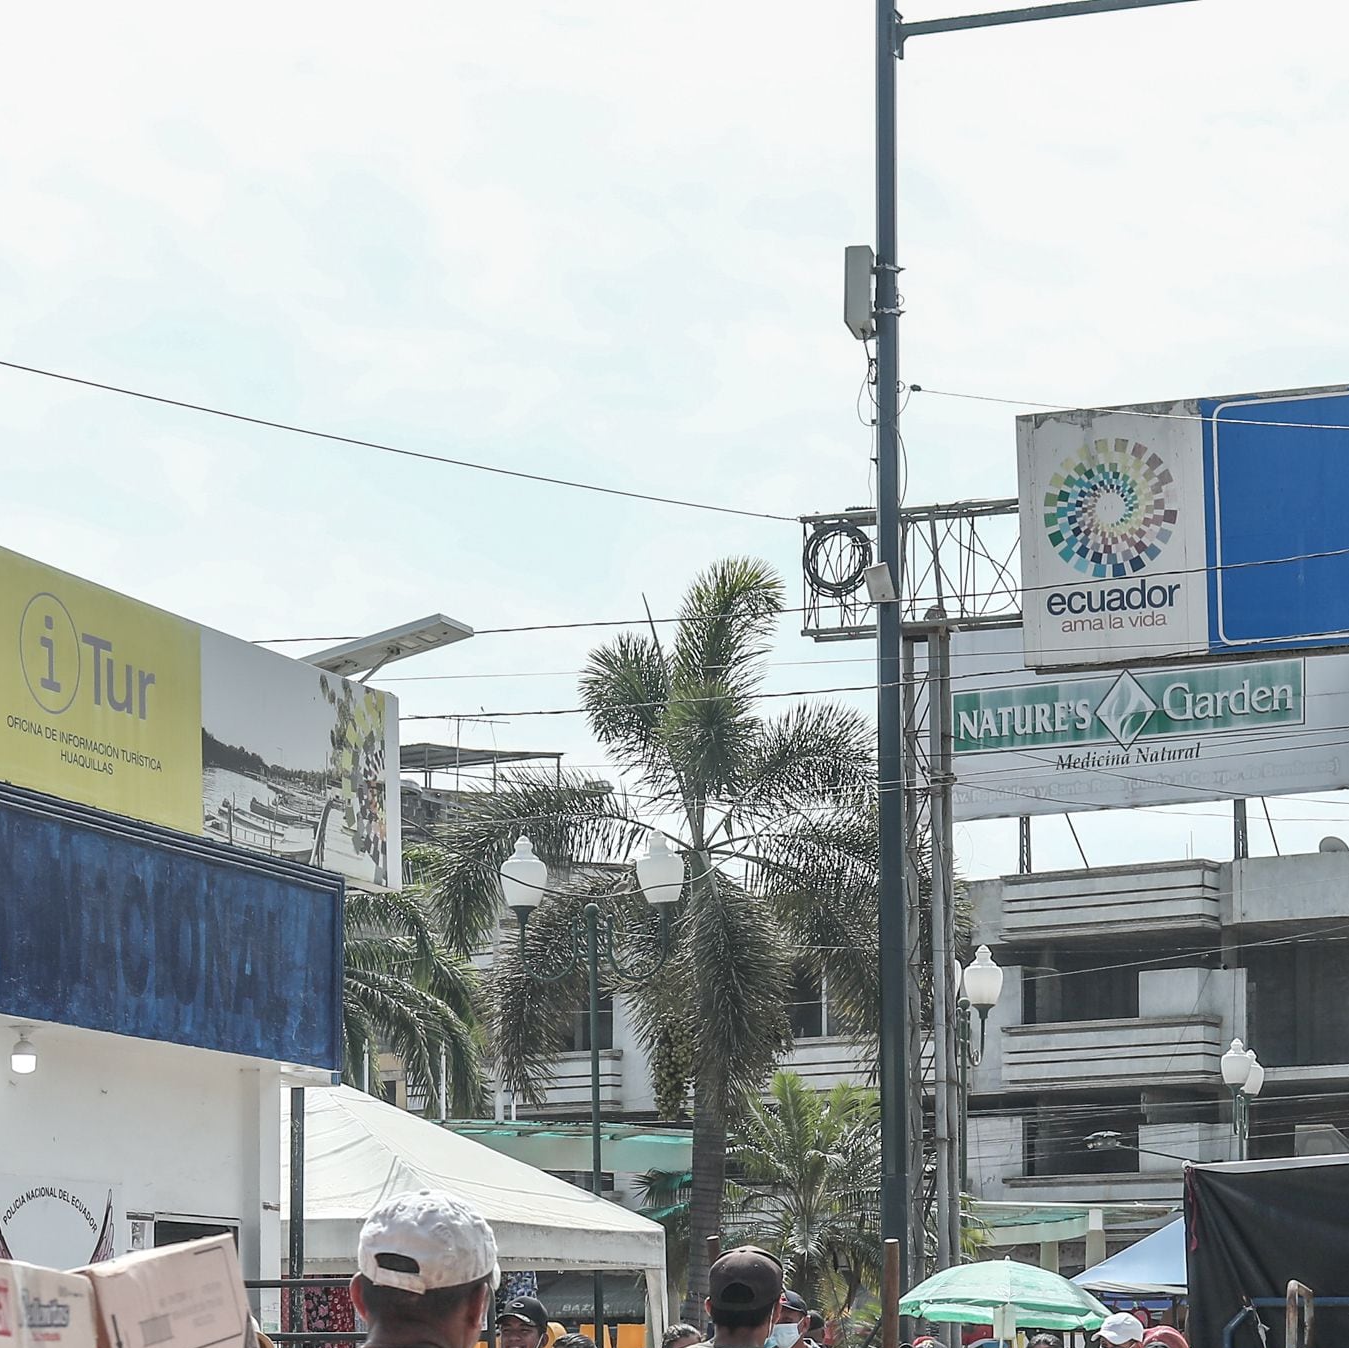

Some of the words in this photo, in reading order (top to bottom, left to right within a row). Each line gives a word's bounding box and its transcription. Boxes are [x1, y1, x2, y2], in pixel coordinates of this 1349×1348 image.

[1047, 579, 1181, 615] ecuador
[1062, 618, 1103, 633] ama
[1109, 614, 1124, 629] la
[1128, 611, 1167, 628] vida
[40, 615, 61, 693] i
[82, 633, 156, 720] Tur
[958, 699, 1092, 741] NATURE'S
[1162, 680, 1294, 721] Garden
[7, 715, 43, 737] OFICINA
[45, 726, 57, 741] DE
[59, 731, 119, 759] INFORMACIÓN
[121, 749, 162, 772] TURÍSTICA
[60, 750, 114, 775] HUAQUILLAS
[1055, 753, 1130, 770] Medicina
[1136, 743, 1201, 763] Natural
[2, 1195, 27, 1226] POLICIA
[25, 1186, 58, 1202] NACIONAL
[58, 1189, 70, 1203] DEL
[70, 1195, 98, 1234] ECUADOR
